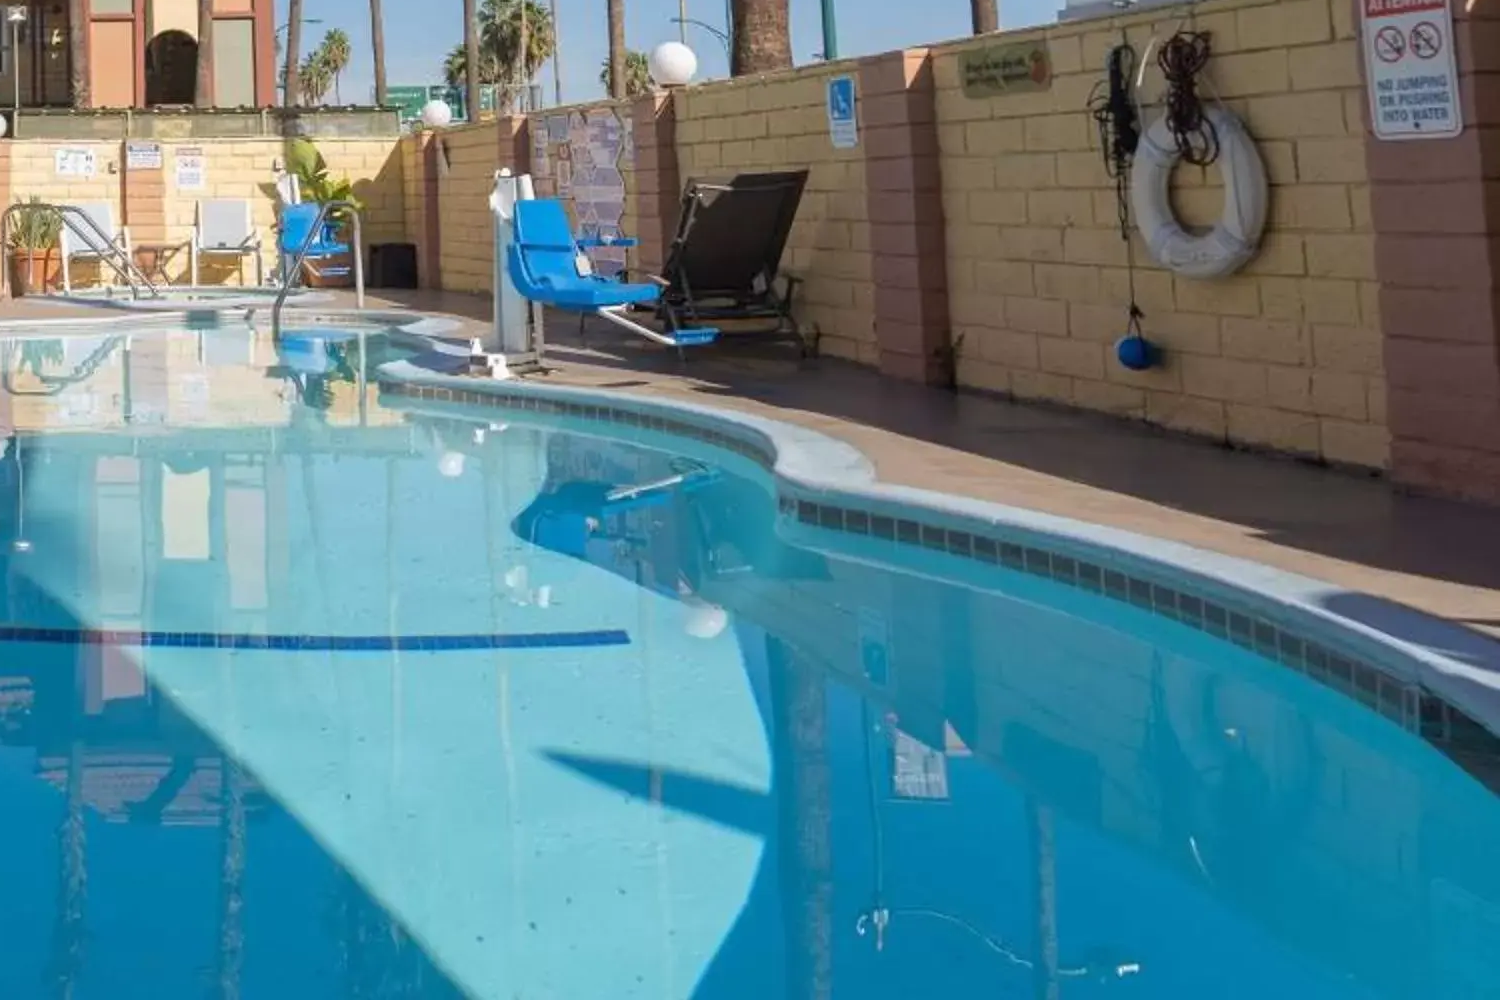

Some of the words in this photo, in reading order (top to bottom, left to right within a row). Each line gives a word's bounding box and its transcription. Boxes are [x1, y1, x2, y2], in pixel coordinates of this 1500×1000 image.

[1377, 79, 1394, 91] NO
[1396, 74, 1448, 91] JUMPING
[1379, 94, 1395, 107] OR
[1398, 90, 1450, 106] PUSHING
[1383, 108, 1408, 122] INTO
[1412, 106, 1449, 121] WATER
